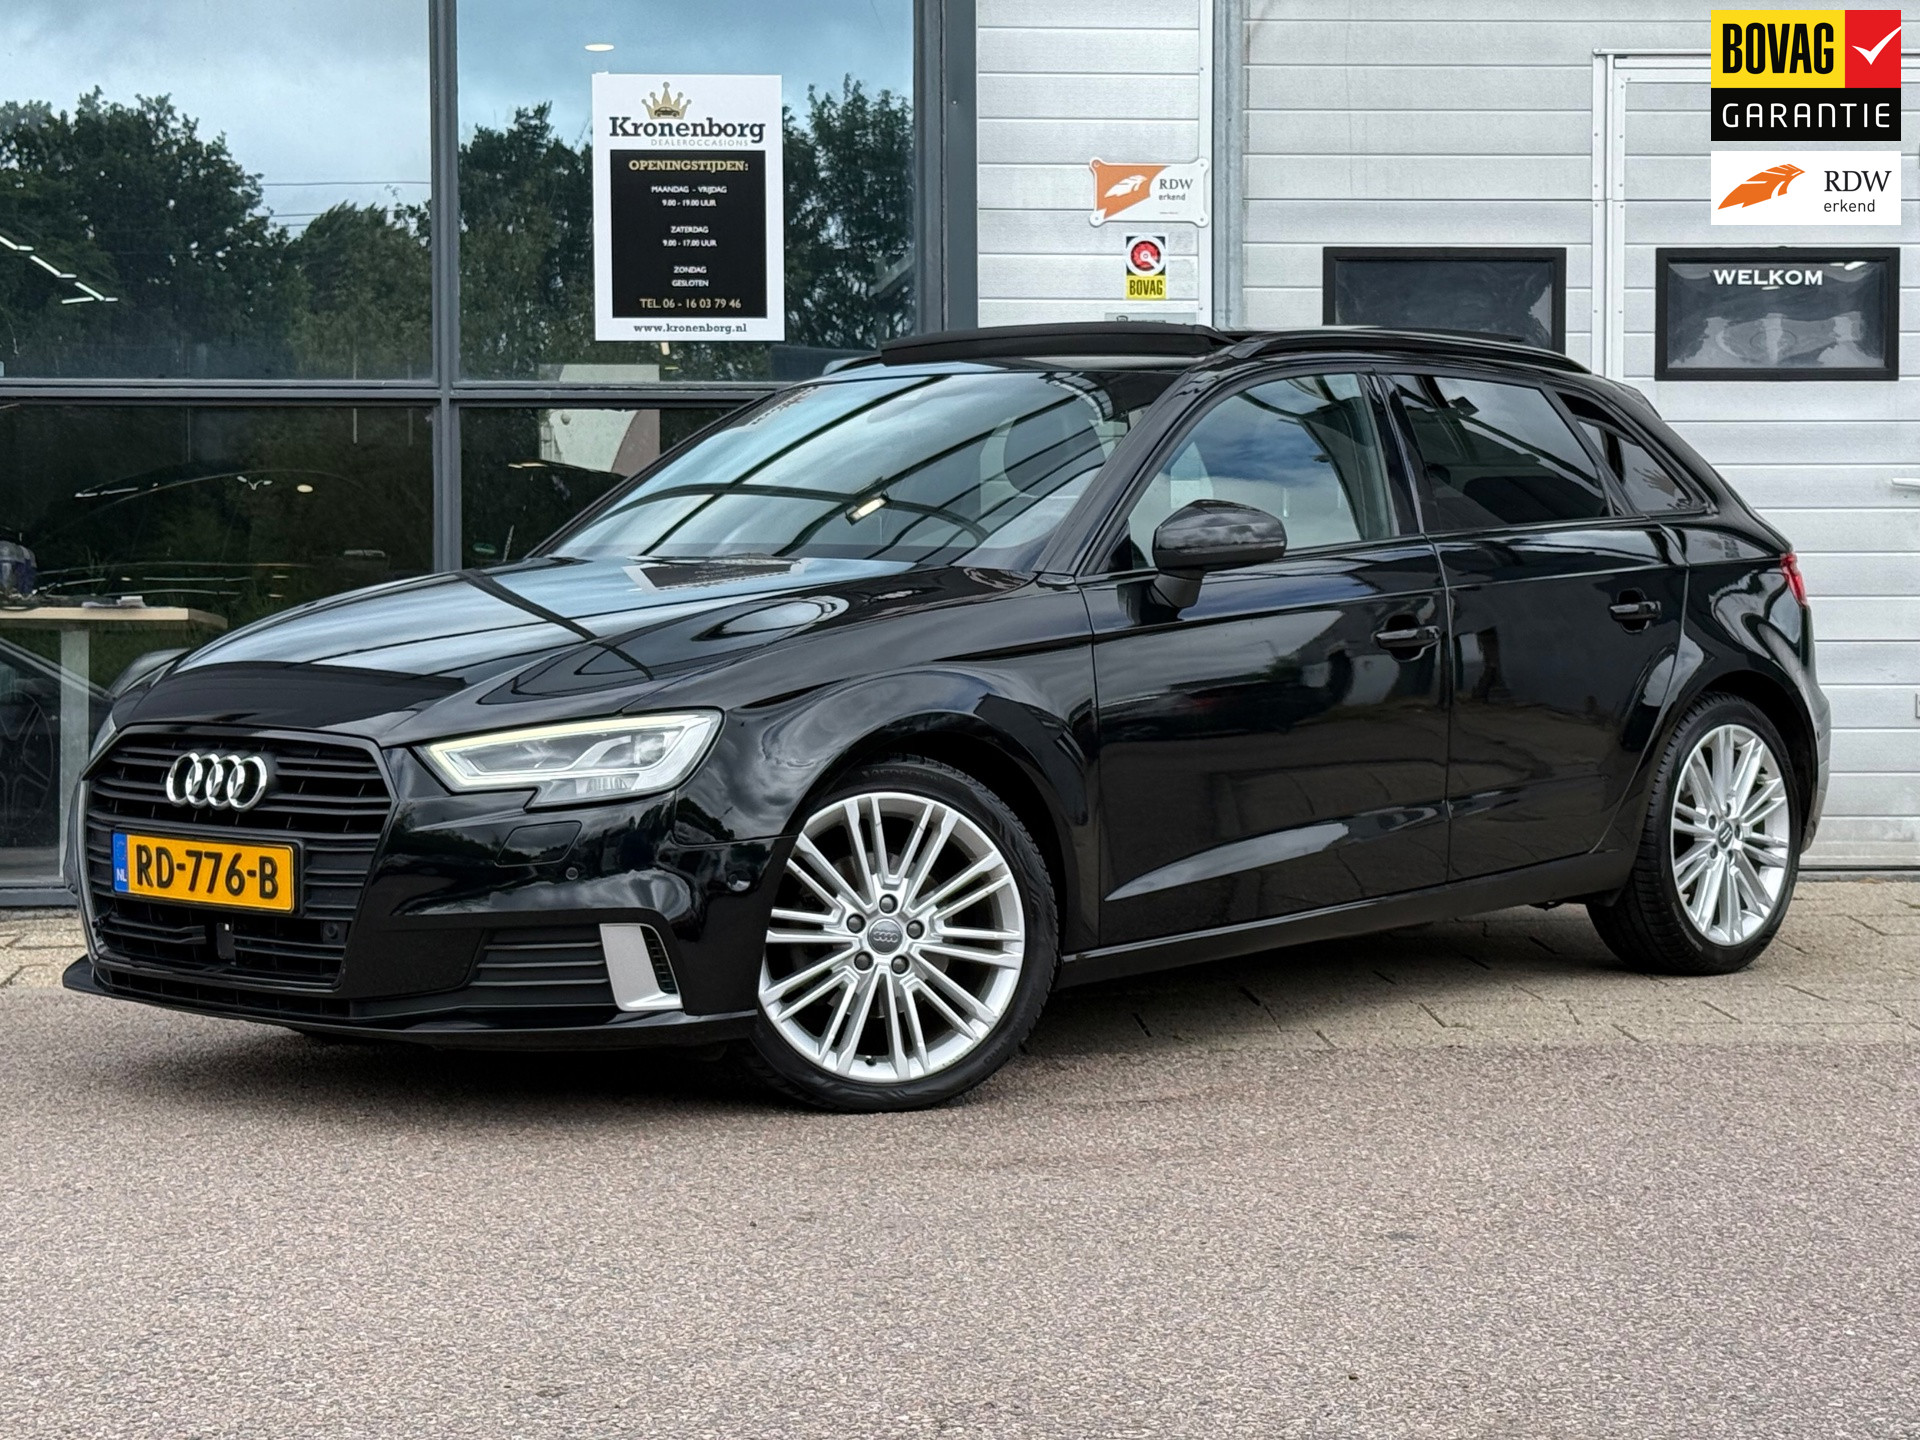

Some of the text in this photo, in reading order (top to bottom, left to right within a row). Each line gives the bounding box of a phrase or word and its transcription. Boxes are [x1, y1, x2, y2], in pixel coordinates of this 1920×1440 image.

[609, 116, 765, 144] Kronenborg
[650, 138, 749, 147] DEALEROCCASIONS
[628, 160, 749, 173] OPENINGSTIJDEN:
[1159, 178, 1193, 190] RDW
[698, 186, 727, 195] VRIJDAG
[1159, 193, 1186, 201] erkend
[700, 199, 717, 207] UUR
[700, 239, 718, 247] UUR
[673, 266, 707, 274] ZONDAG
[671, 279, 709, 287] GESLOTEN
[1713, 269, 1823, 286] WELKOM
[1129, 279, 1163, 296] BOVAG
[662, 298, 676, 309] 06
[686, 298, 697, 309] 16
[699, 298, 712, 309] 03
[714, 298, 727, 309] 79
[728, 298, 742, 309] 46
[633, 323, 747, 335] www.kronenborg.nl
[116, 867, 128, 883] NL
[136, 844, 279, 900] RD-776-B
